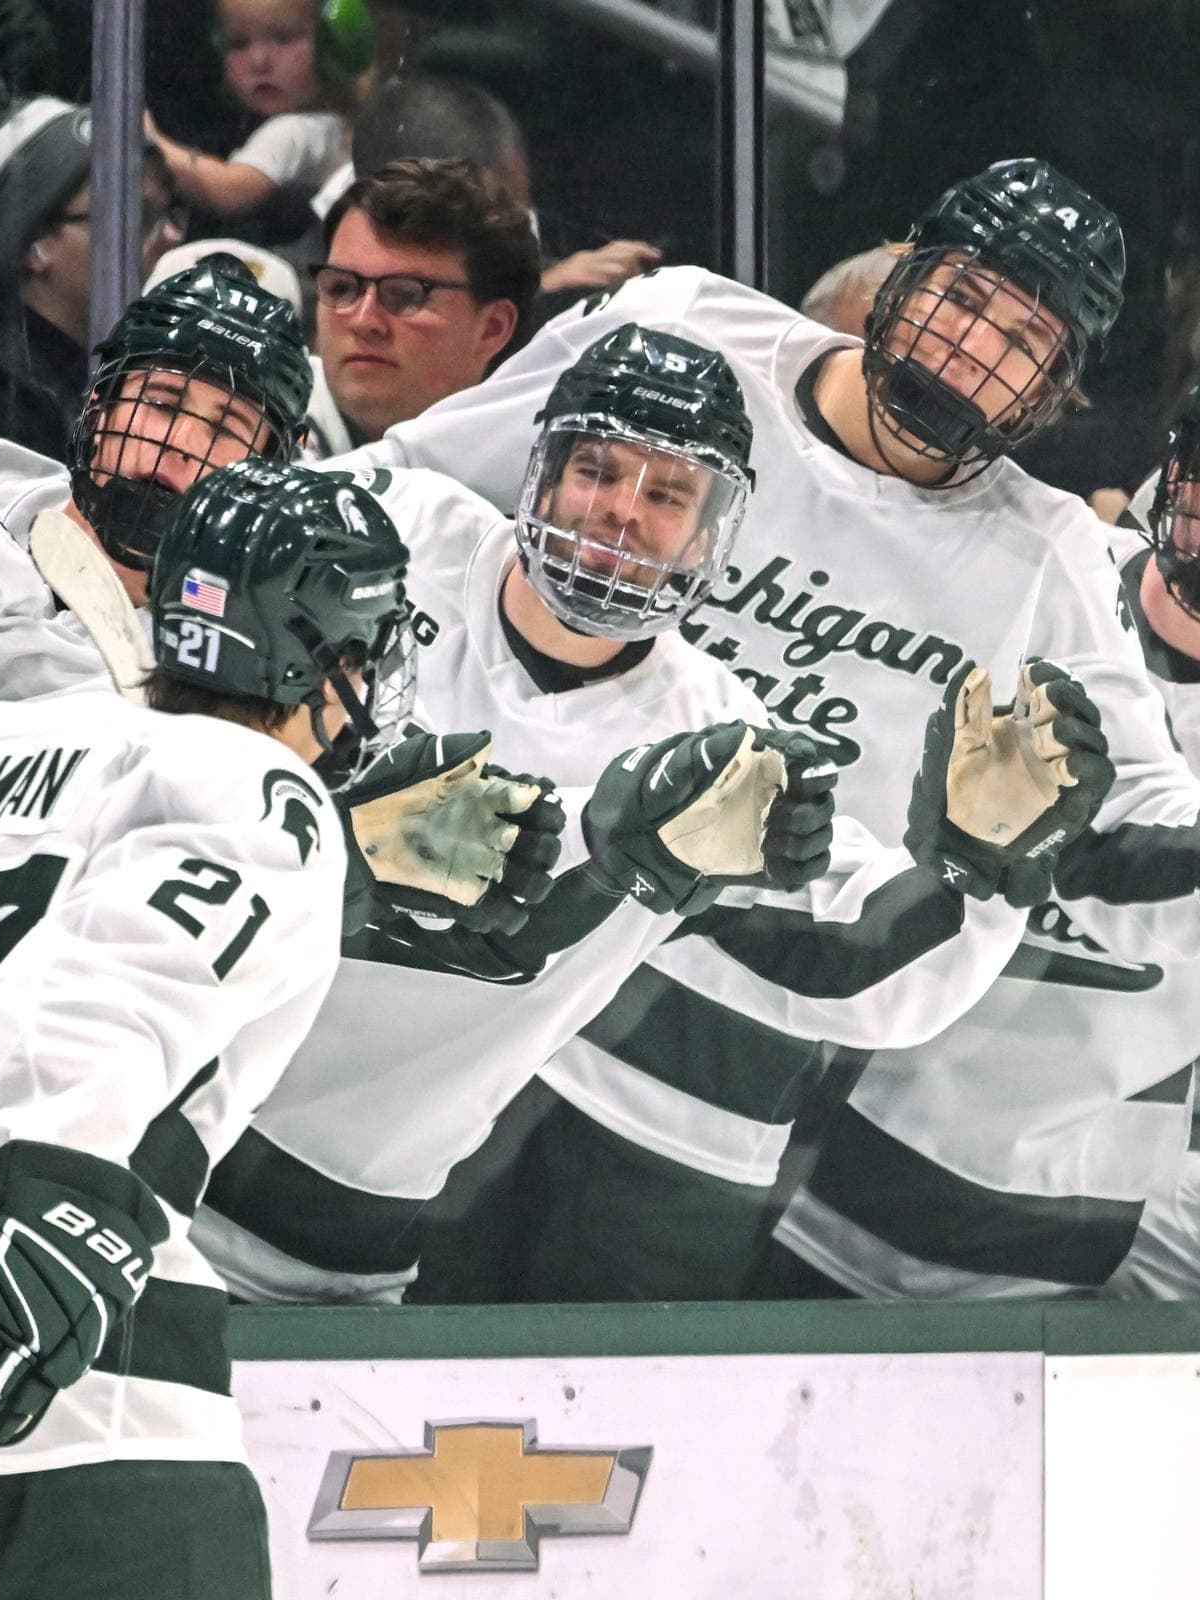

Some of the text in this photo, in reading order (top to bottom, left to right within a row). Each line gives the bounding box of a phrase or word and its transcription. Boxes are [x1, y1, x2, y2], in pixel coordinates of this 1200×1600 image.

[1055, 207, 1079, 231] 4
[177, 620, 220, 673] 21
[146, 858, 272, 983] 21
[42, 1201, 149, 1292] BAU
